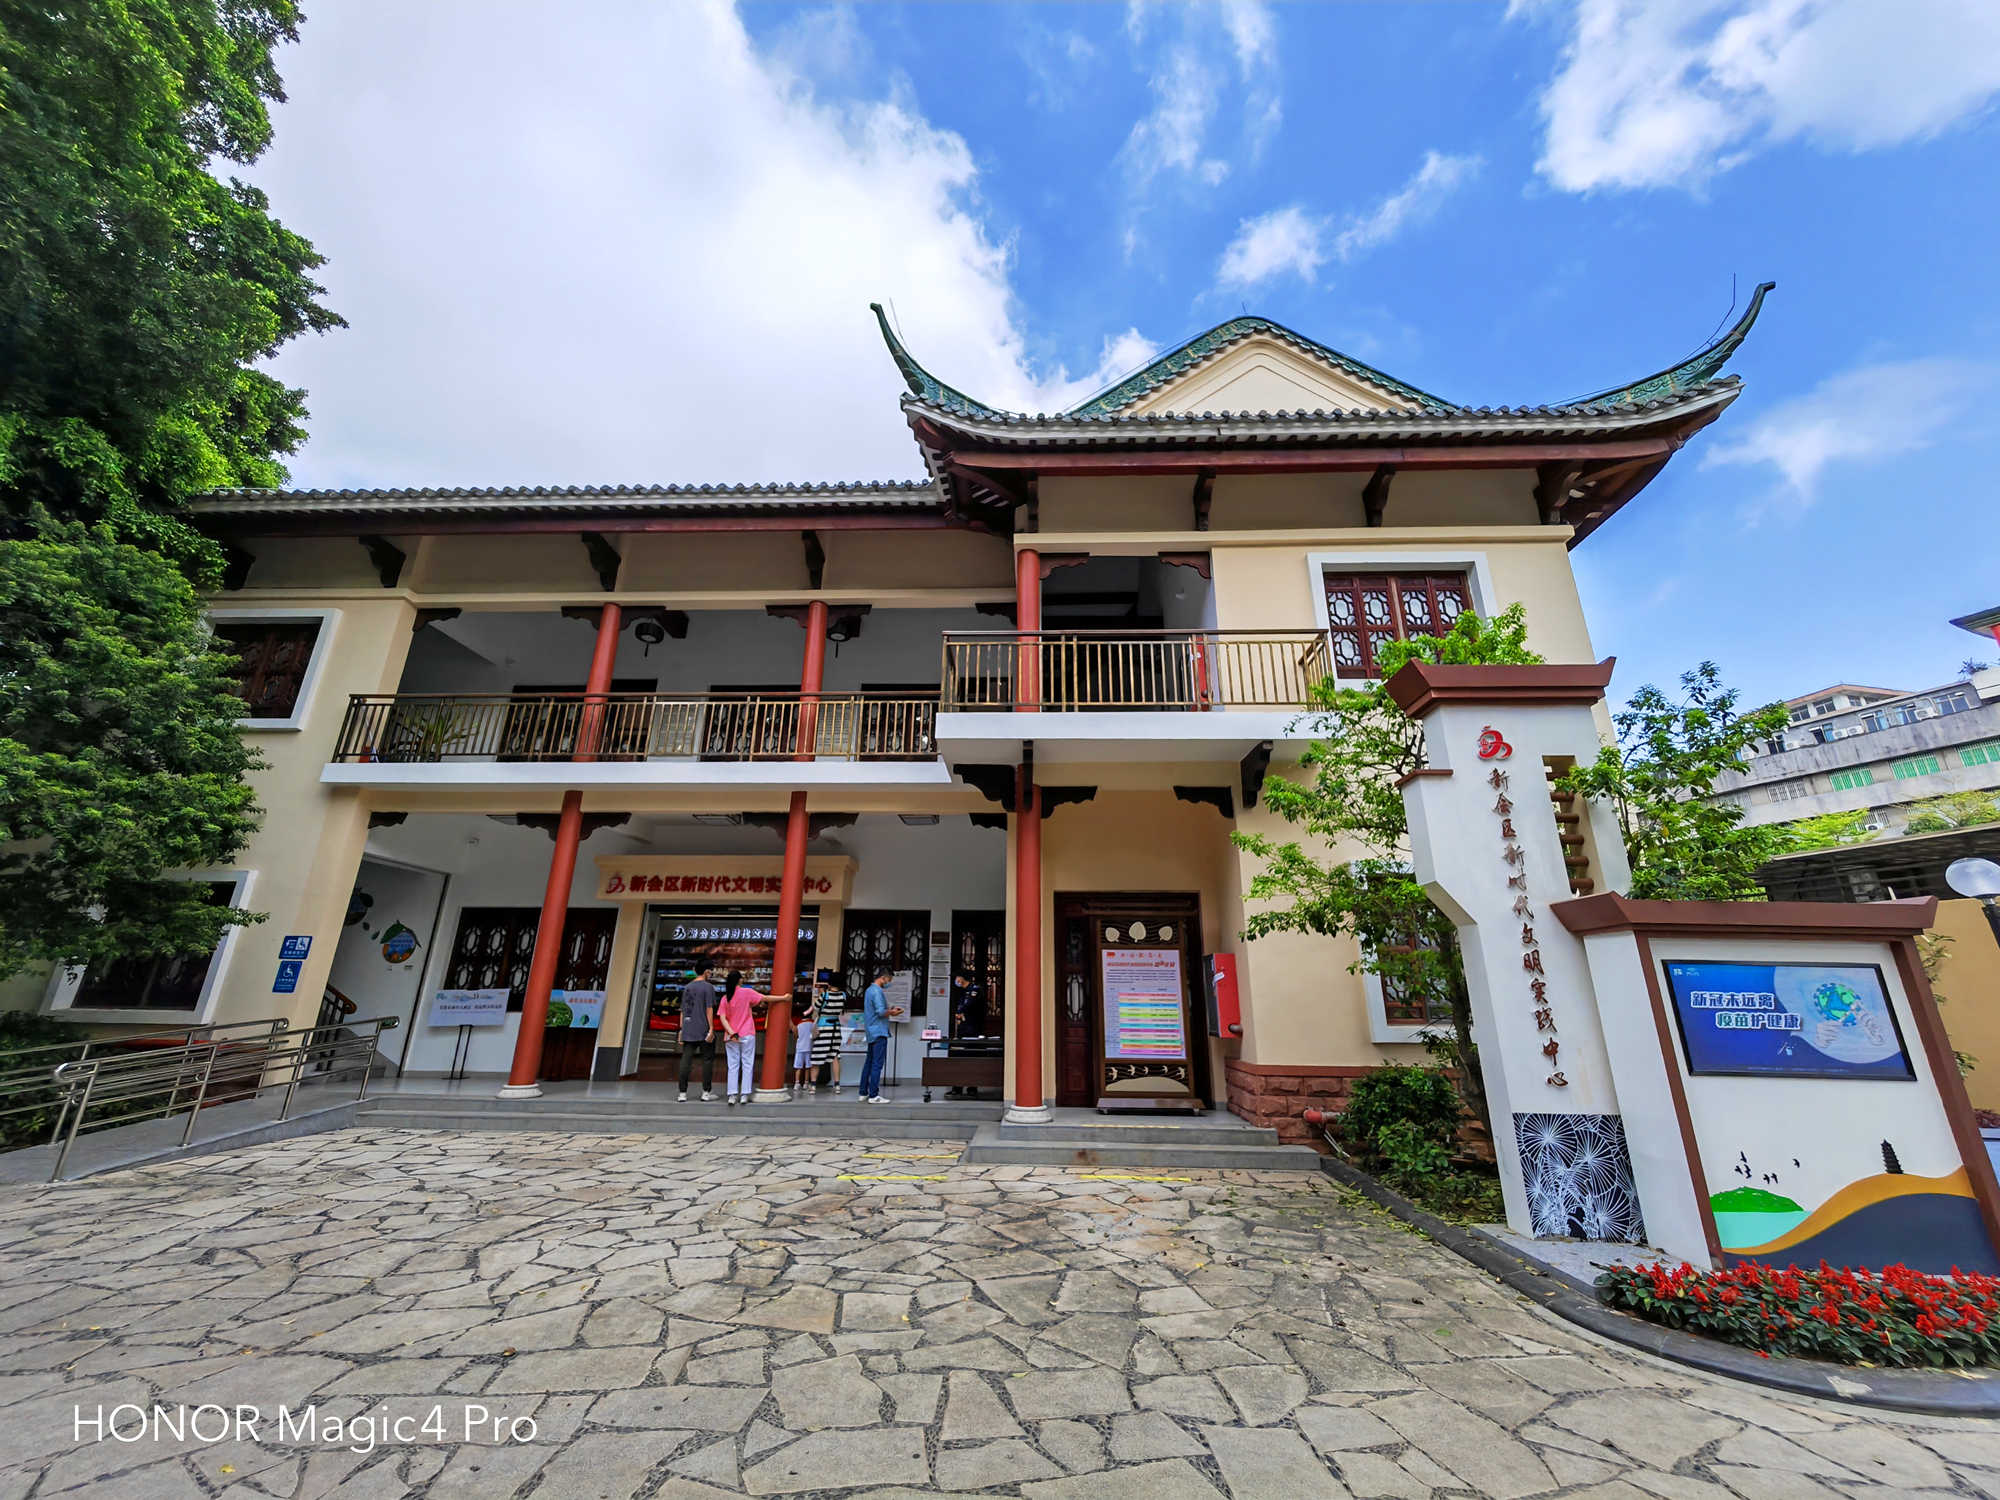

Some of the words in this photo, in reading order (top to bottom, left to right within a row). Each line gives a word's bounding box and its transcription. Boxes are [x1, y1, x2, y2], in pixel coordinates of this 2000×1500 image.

[630, 875, 832, 893] 新会区新时代文明实中心
[1487, 767, 1569, 1088] 新会区新时代文明实践中心
[1691, 991, 1775, 1010] 新冠未远离
[1715, 1012, 1801, 1029] 疫苗护健康
